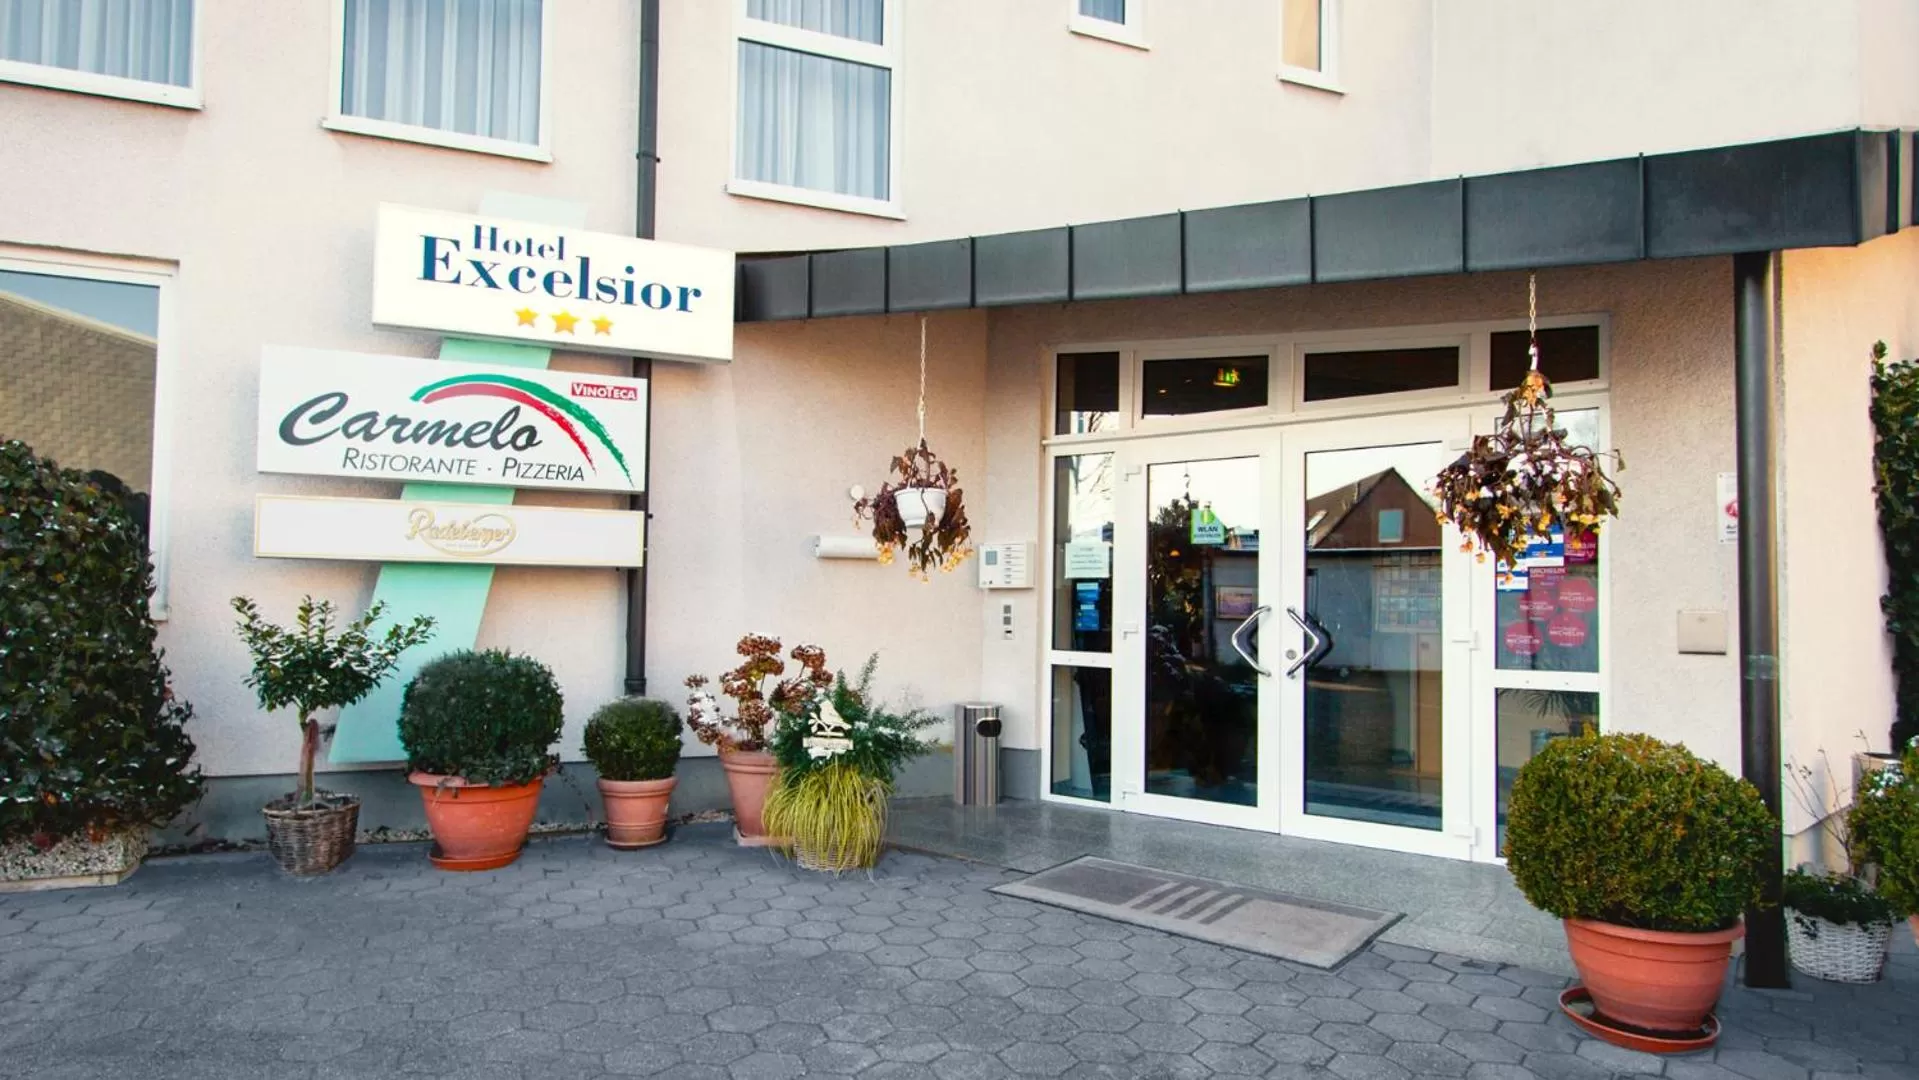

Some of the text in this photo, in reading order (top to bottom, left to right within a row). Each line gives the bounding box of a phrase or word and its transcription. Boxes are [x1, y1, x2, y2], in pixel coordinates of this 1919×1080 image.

[473, 224, 565, 261] Hotel
[416, 234, 703, 313] Excelsior
[572, 382, 636, 400] VINOTECA
[278, 391, 543, 452] Carmelo
[342, 447, 586, 482] RISTORANTE PIZZERIA
